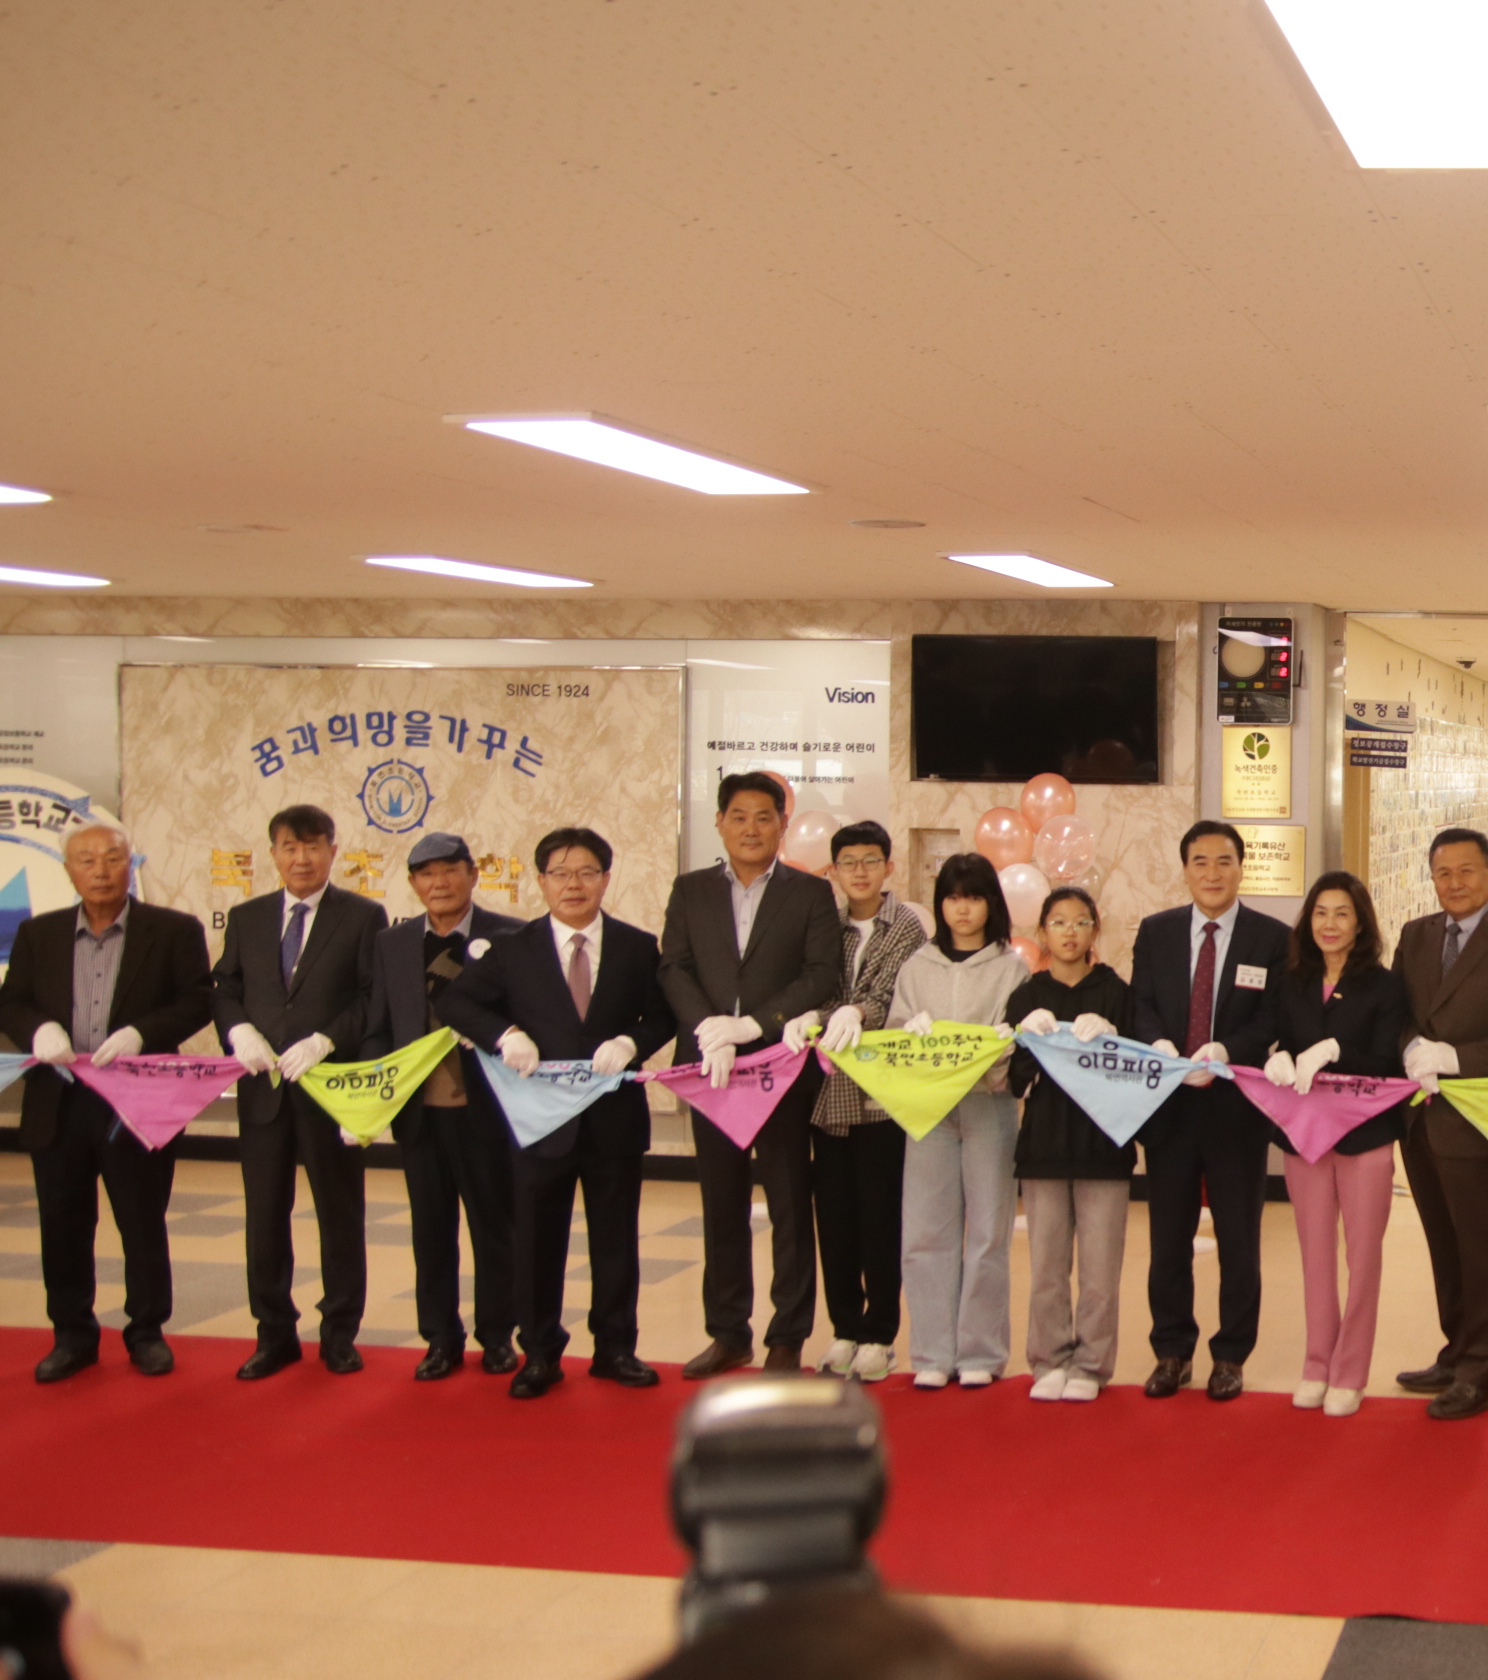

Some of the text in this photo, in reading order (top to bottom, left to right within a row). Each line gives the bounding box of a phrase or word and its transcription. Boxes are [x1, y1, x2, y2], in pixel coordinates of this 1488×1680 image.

[506, 683, 590, 698] SINCE 1924
[825, 687, 876, 704] Vision
[707, 740, 876, 753] 예절바르고 건강하며 슬기로운 어린이
[1234, 764, 1278, 774] 녹색건축인증
[885, 1052, 974, 1067] 북면초등학교
[1078, 1041, 1162, 1090] 이음피움
